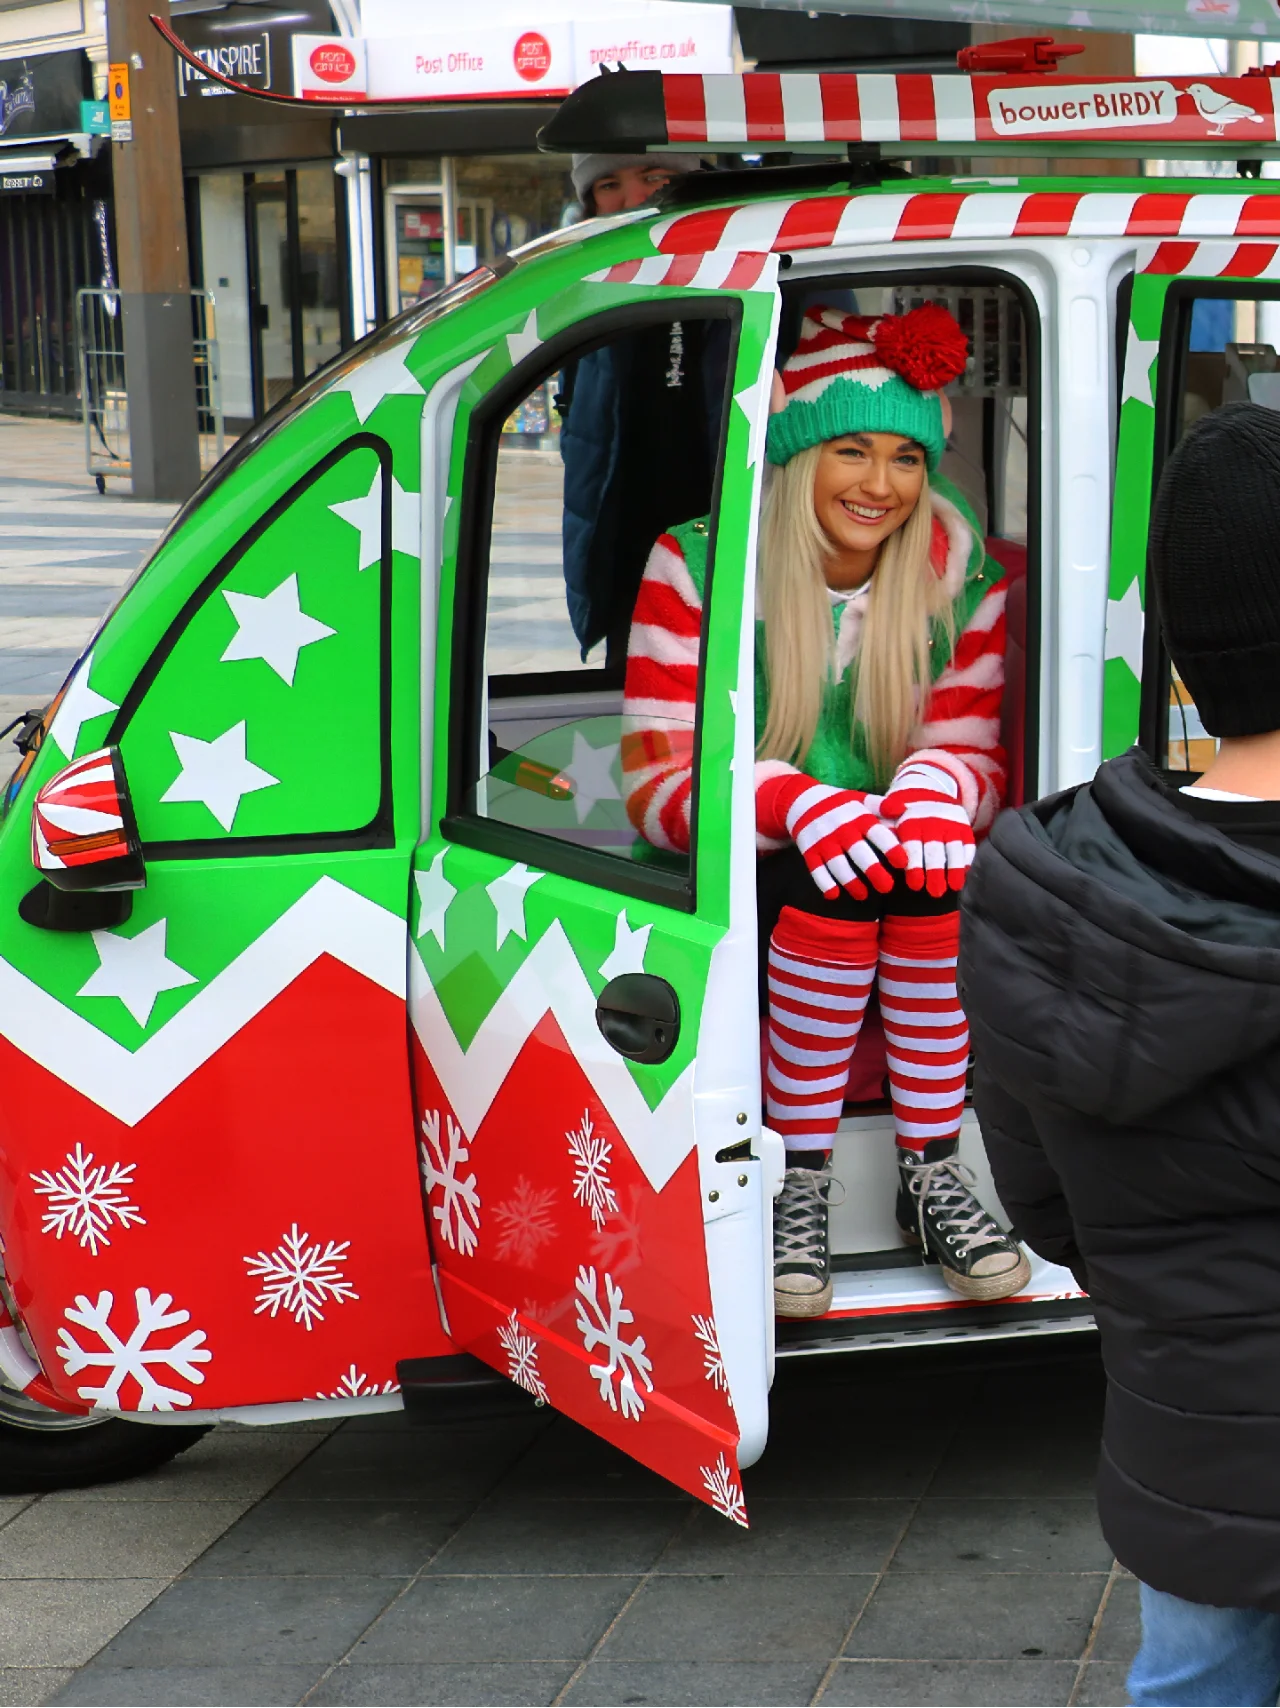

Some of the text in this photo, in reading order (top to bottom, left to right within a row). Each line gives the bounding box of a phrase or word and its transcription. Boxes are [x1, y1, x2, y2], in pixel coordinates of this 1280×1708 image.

[521, 42, 544, 56] POST
[415, 53, 484, 73] Post Office
[517, 56, 547, 70] OFFICE
[999, 90, 1164, 125] bowerBIRDY
